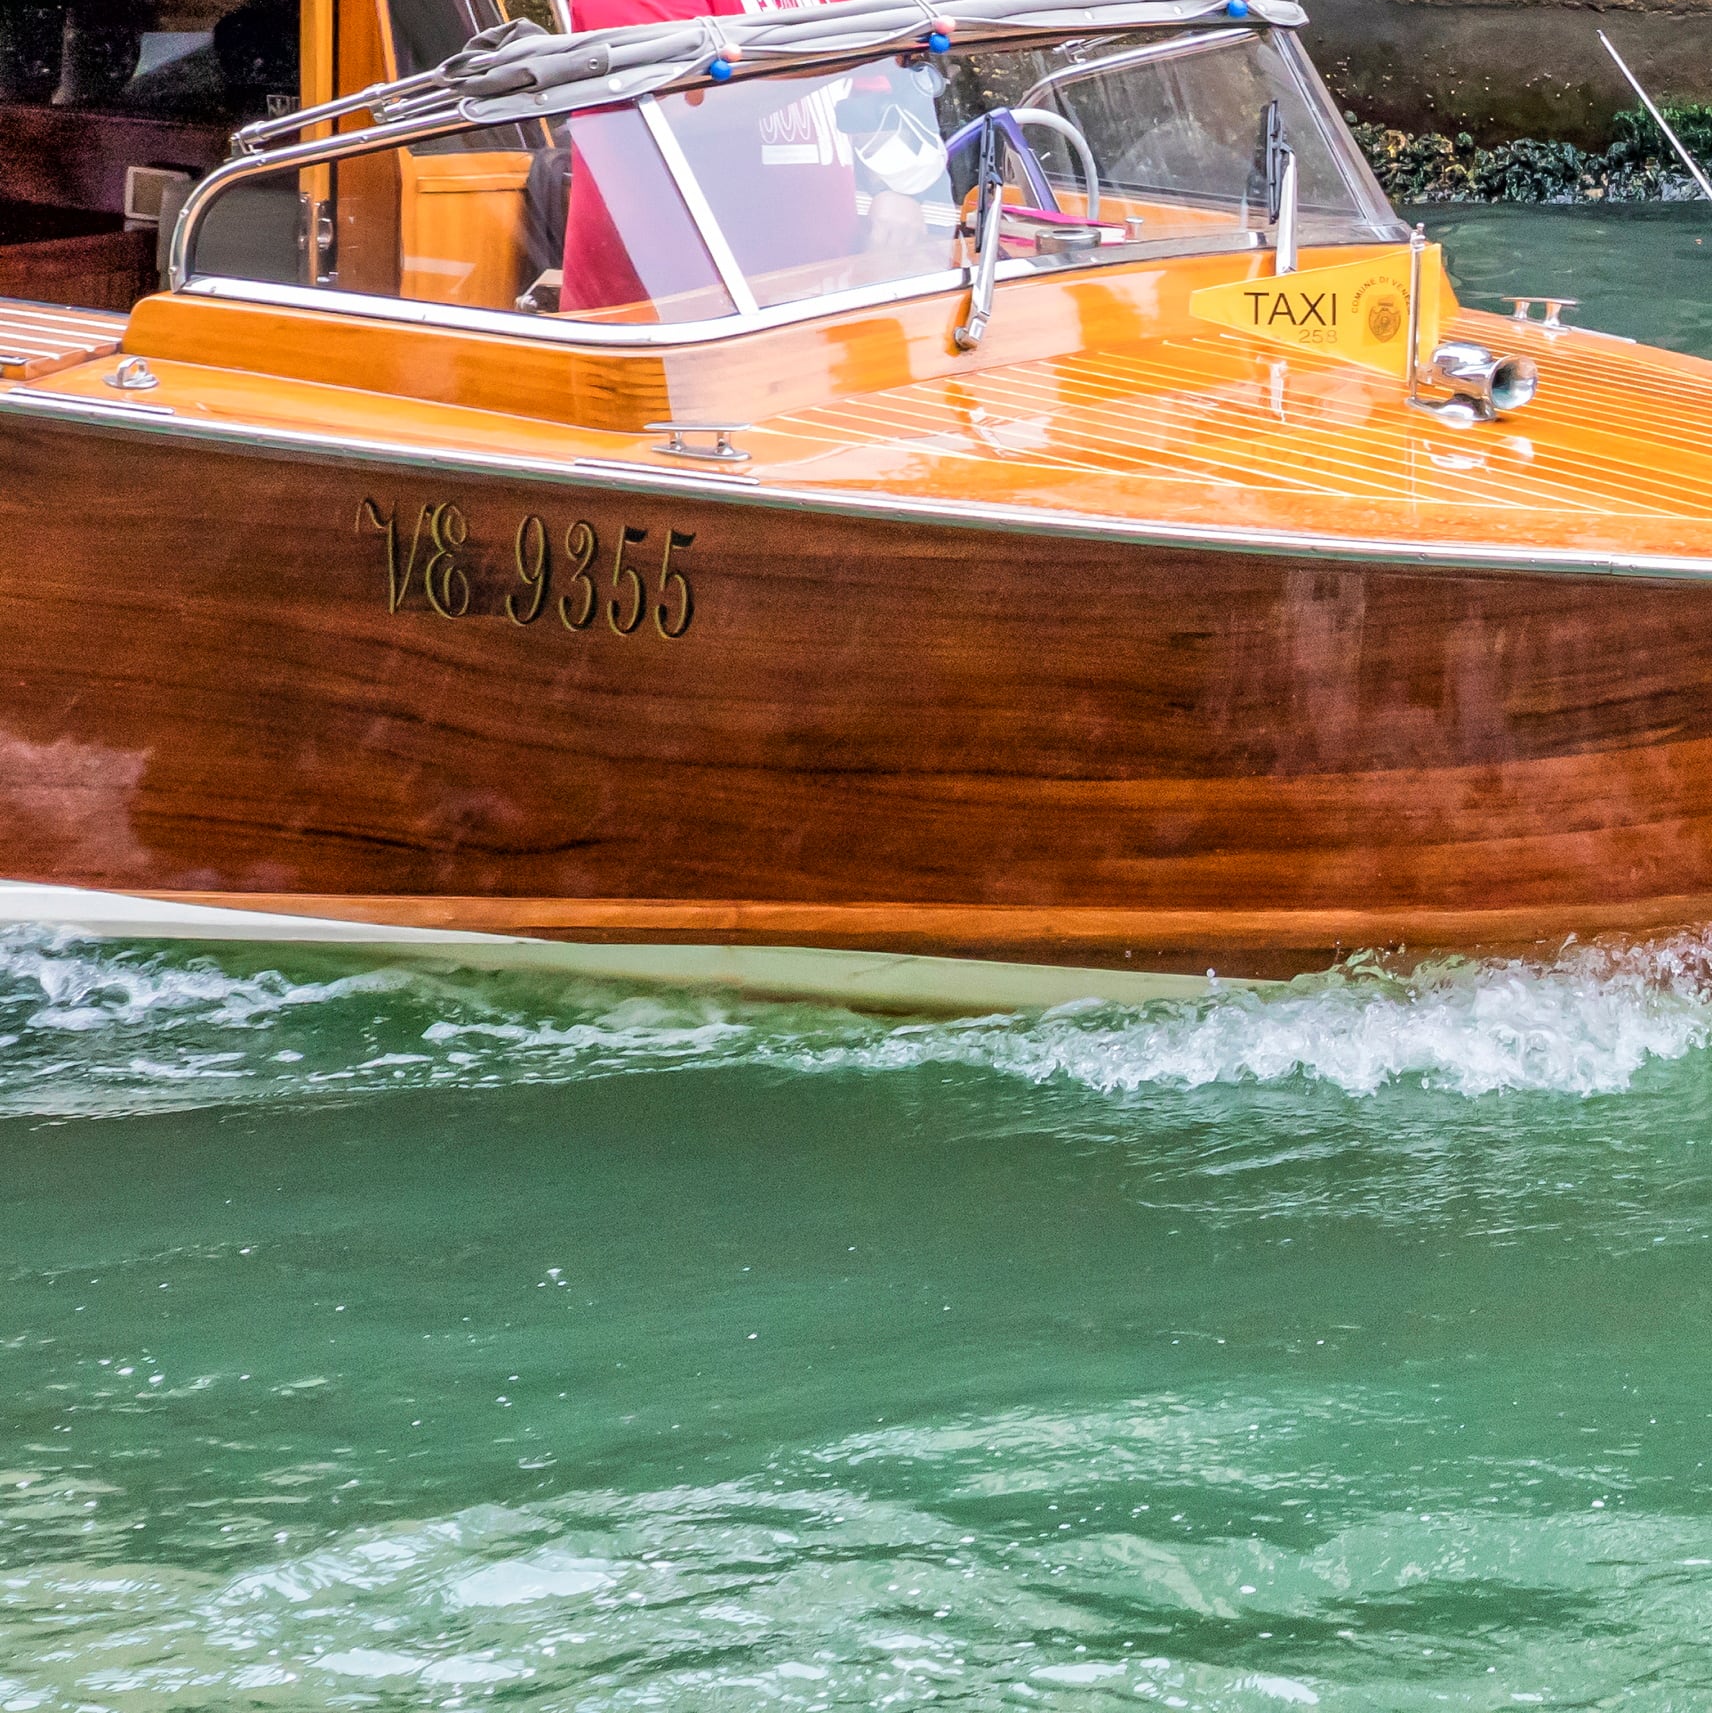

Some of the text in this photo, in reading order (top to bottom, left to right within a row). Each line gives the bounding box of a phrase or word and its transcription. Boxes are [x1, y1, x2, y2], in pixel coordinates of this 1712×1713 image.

[1243, 291, 1337, 326] TAXI
[1351, 277, 1377, 314] COMUNE
[1379, 275, 1389, 284] DI
[1298, 328, 1338, 344] 258
[354, 496, 697, 639] VE 9355
